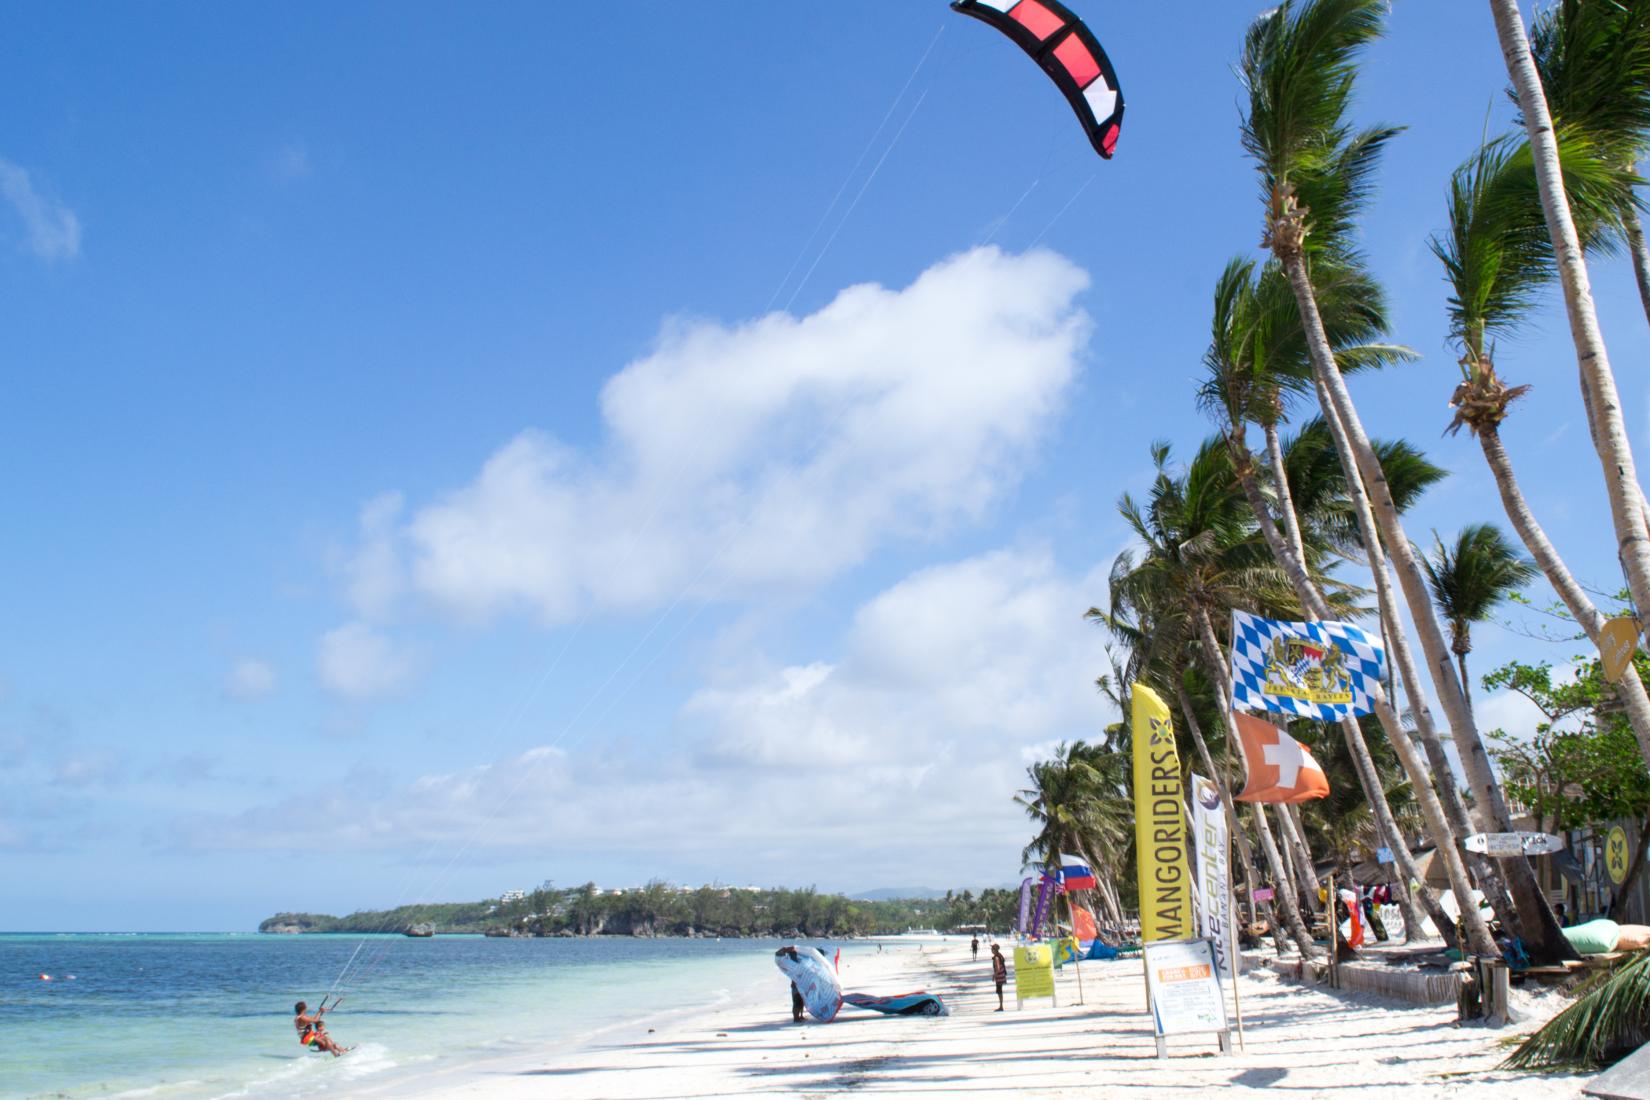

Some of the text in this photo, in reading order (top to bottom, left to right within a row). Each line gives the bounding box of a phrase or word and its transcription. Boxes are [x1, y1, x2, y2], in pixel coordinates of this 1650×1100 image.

[1151, 750, 1183, 941] MANGORIDERS
[1218, 842, 1230, 928] BANANA BAY
